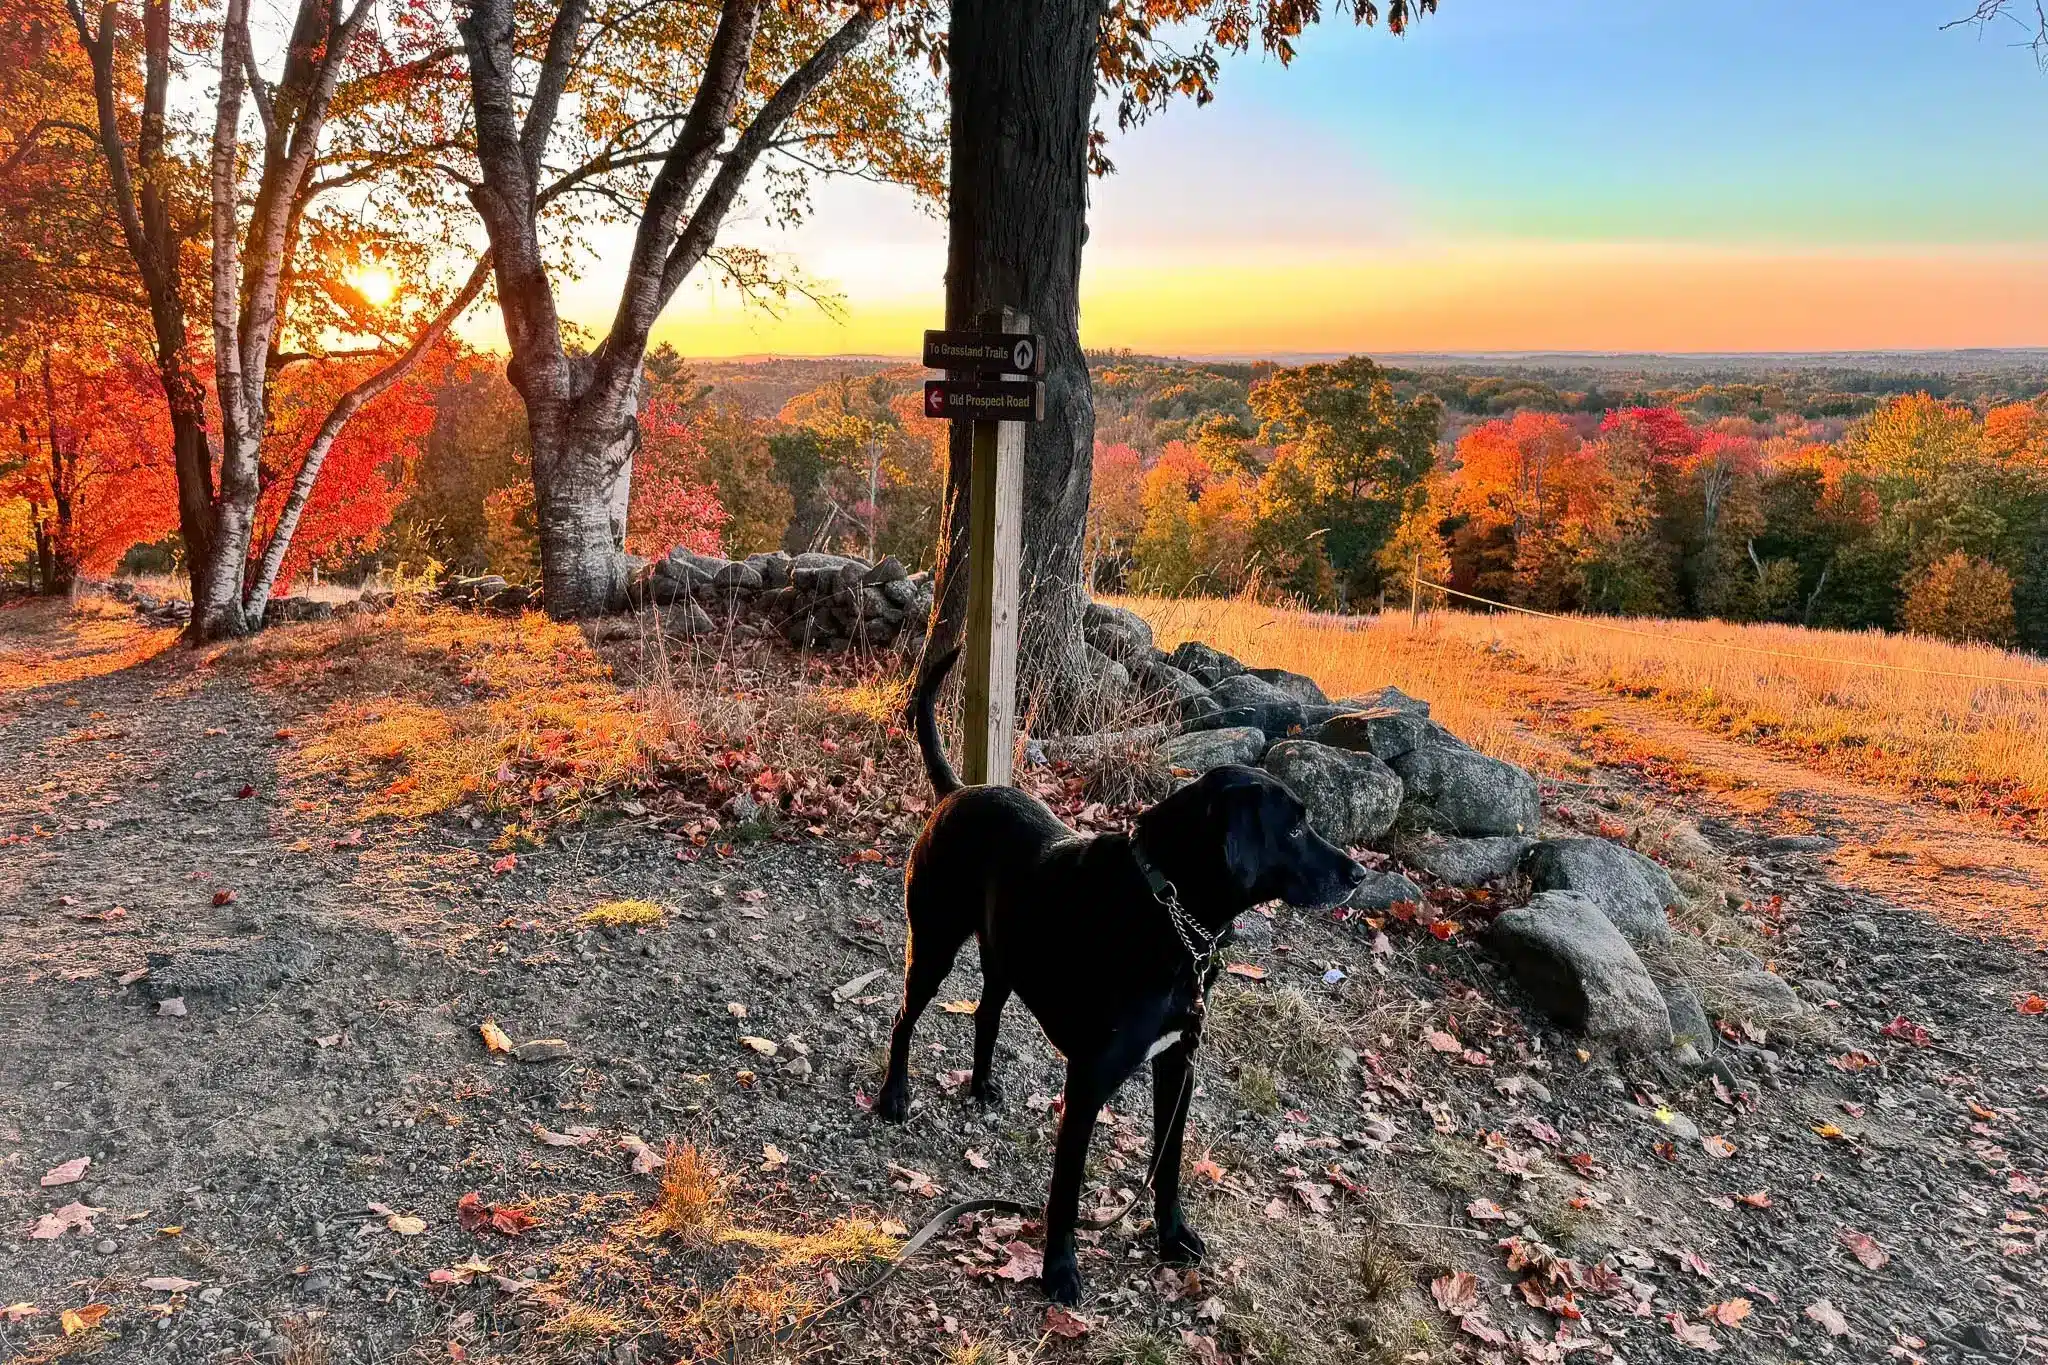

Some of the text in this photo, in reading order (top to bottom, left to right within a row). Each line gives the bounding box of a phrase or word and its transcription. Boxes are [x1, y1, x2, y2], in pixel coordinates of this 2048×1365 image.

[929, 343, 1009, 359] To Grassland Trails
[949, 394, 1030, 409] Old Prospect Road
